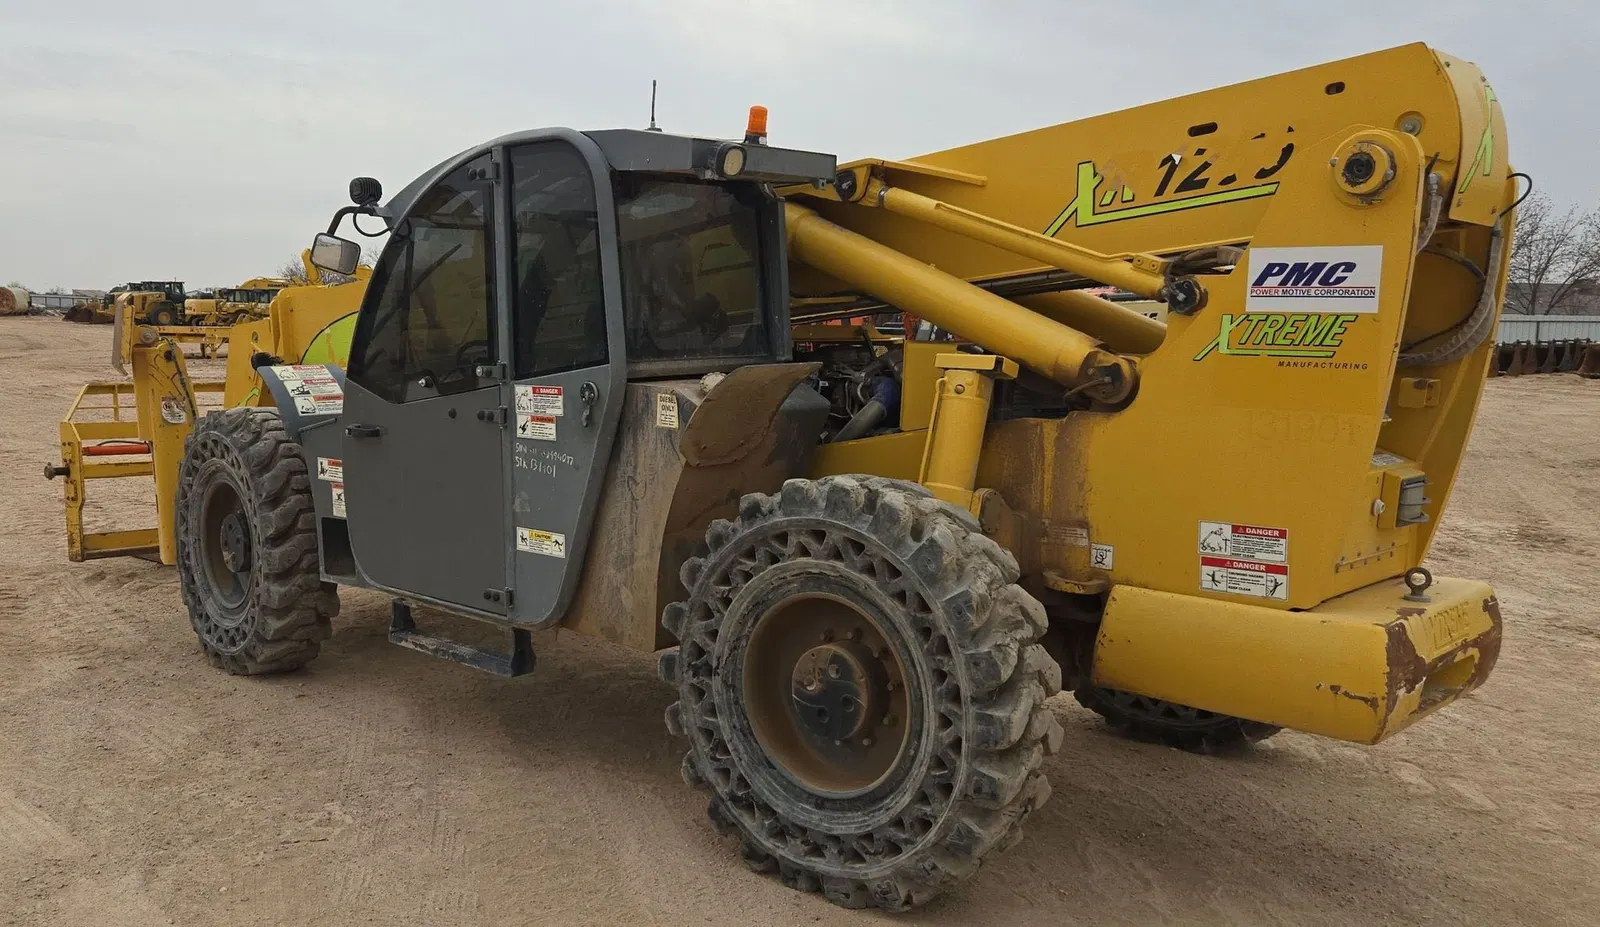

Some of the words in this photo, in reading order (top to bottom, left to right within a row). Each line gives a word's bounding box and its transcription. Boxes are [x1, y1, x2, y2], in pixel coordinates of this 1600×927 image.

[1252, 261, 1357, 287] PMC
[1250, 288, 1280, 296] POWER
[1281, 288, 1312, 297] MOTIVE
[1313, 288, 1376, 297] CORPORATION
[1192, 313, 1359, 361] XTREME
[1277, 360, 1369, 371] MANUFACTURING
[661, 404, 675, 412] ONLY
[1245, 527, 1280, 537] DANGER
[1232, 561, 1266, 571] DANGER
